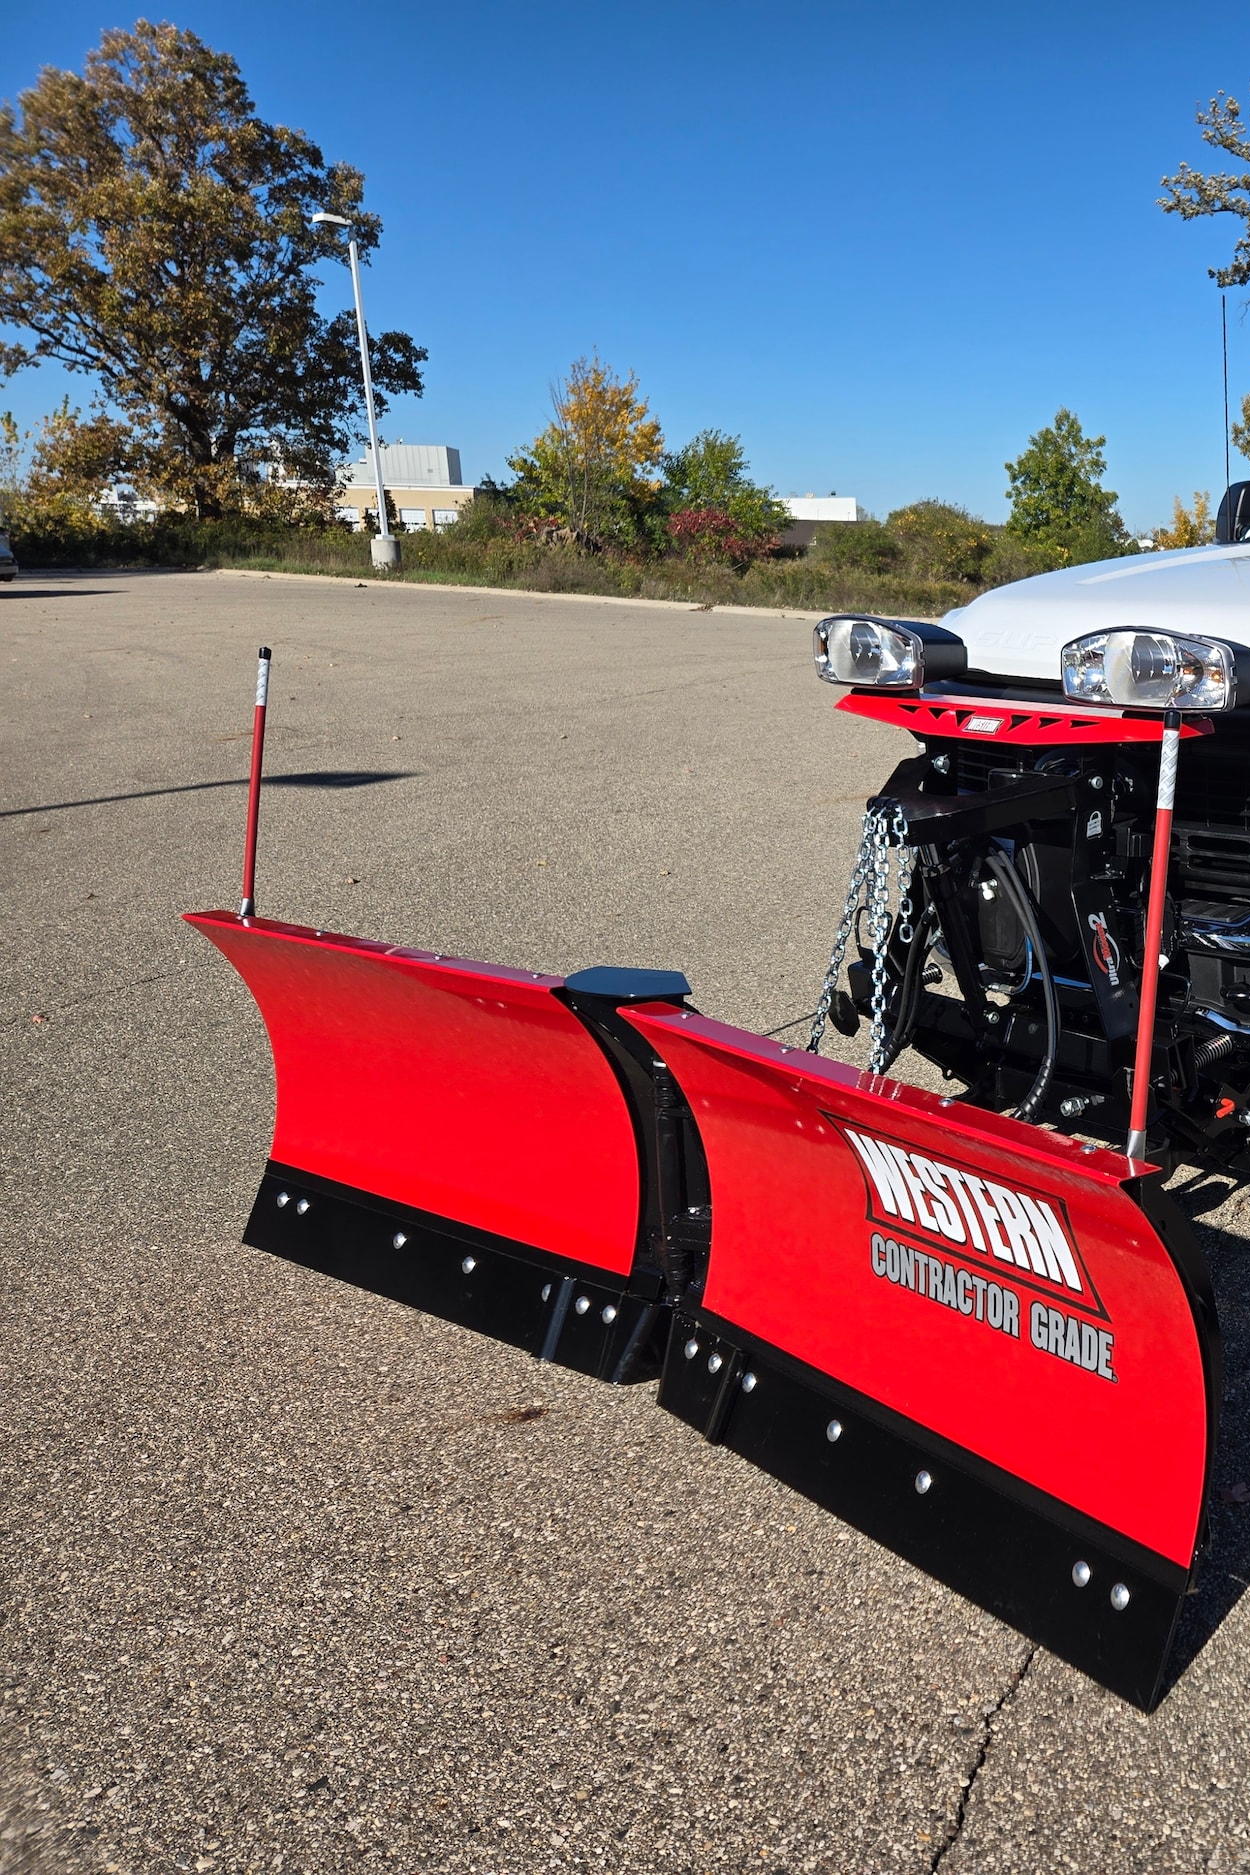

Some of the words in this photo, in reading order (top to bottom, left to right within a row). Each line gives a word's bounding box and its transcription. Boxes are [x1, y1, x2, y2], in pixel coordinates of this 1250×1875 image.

[976, 631, 1058, 650] SUP
[843, 1127, 1083, 1293] WESTERN
[870, 1232, 1021, 1339] CONTRACTOR
[1030, 1300, 1116, 1382] GRADE
